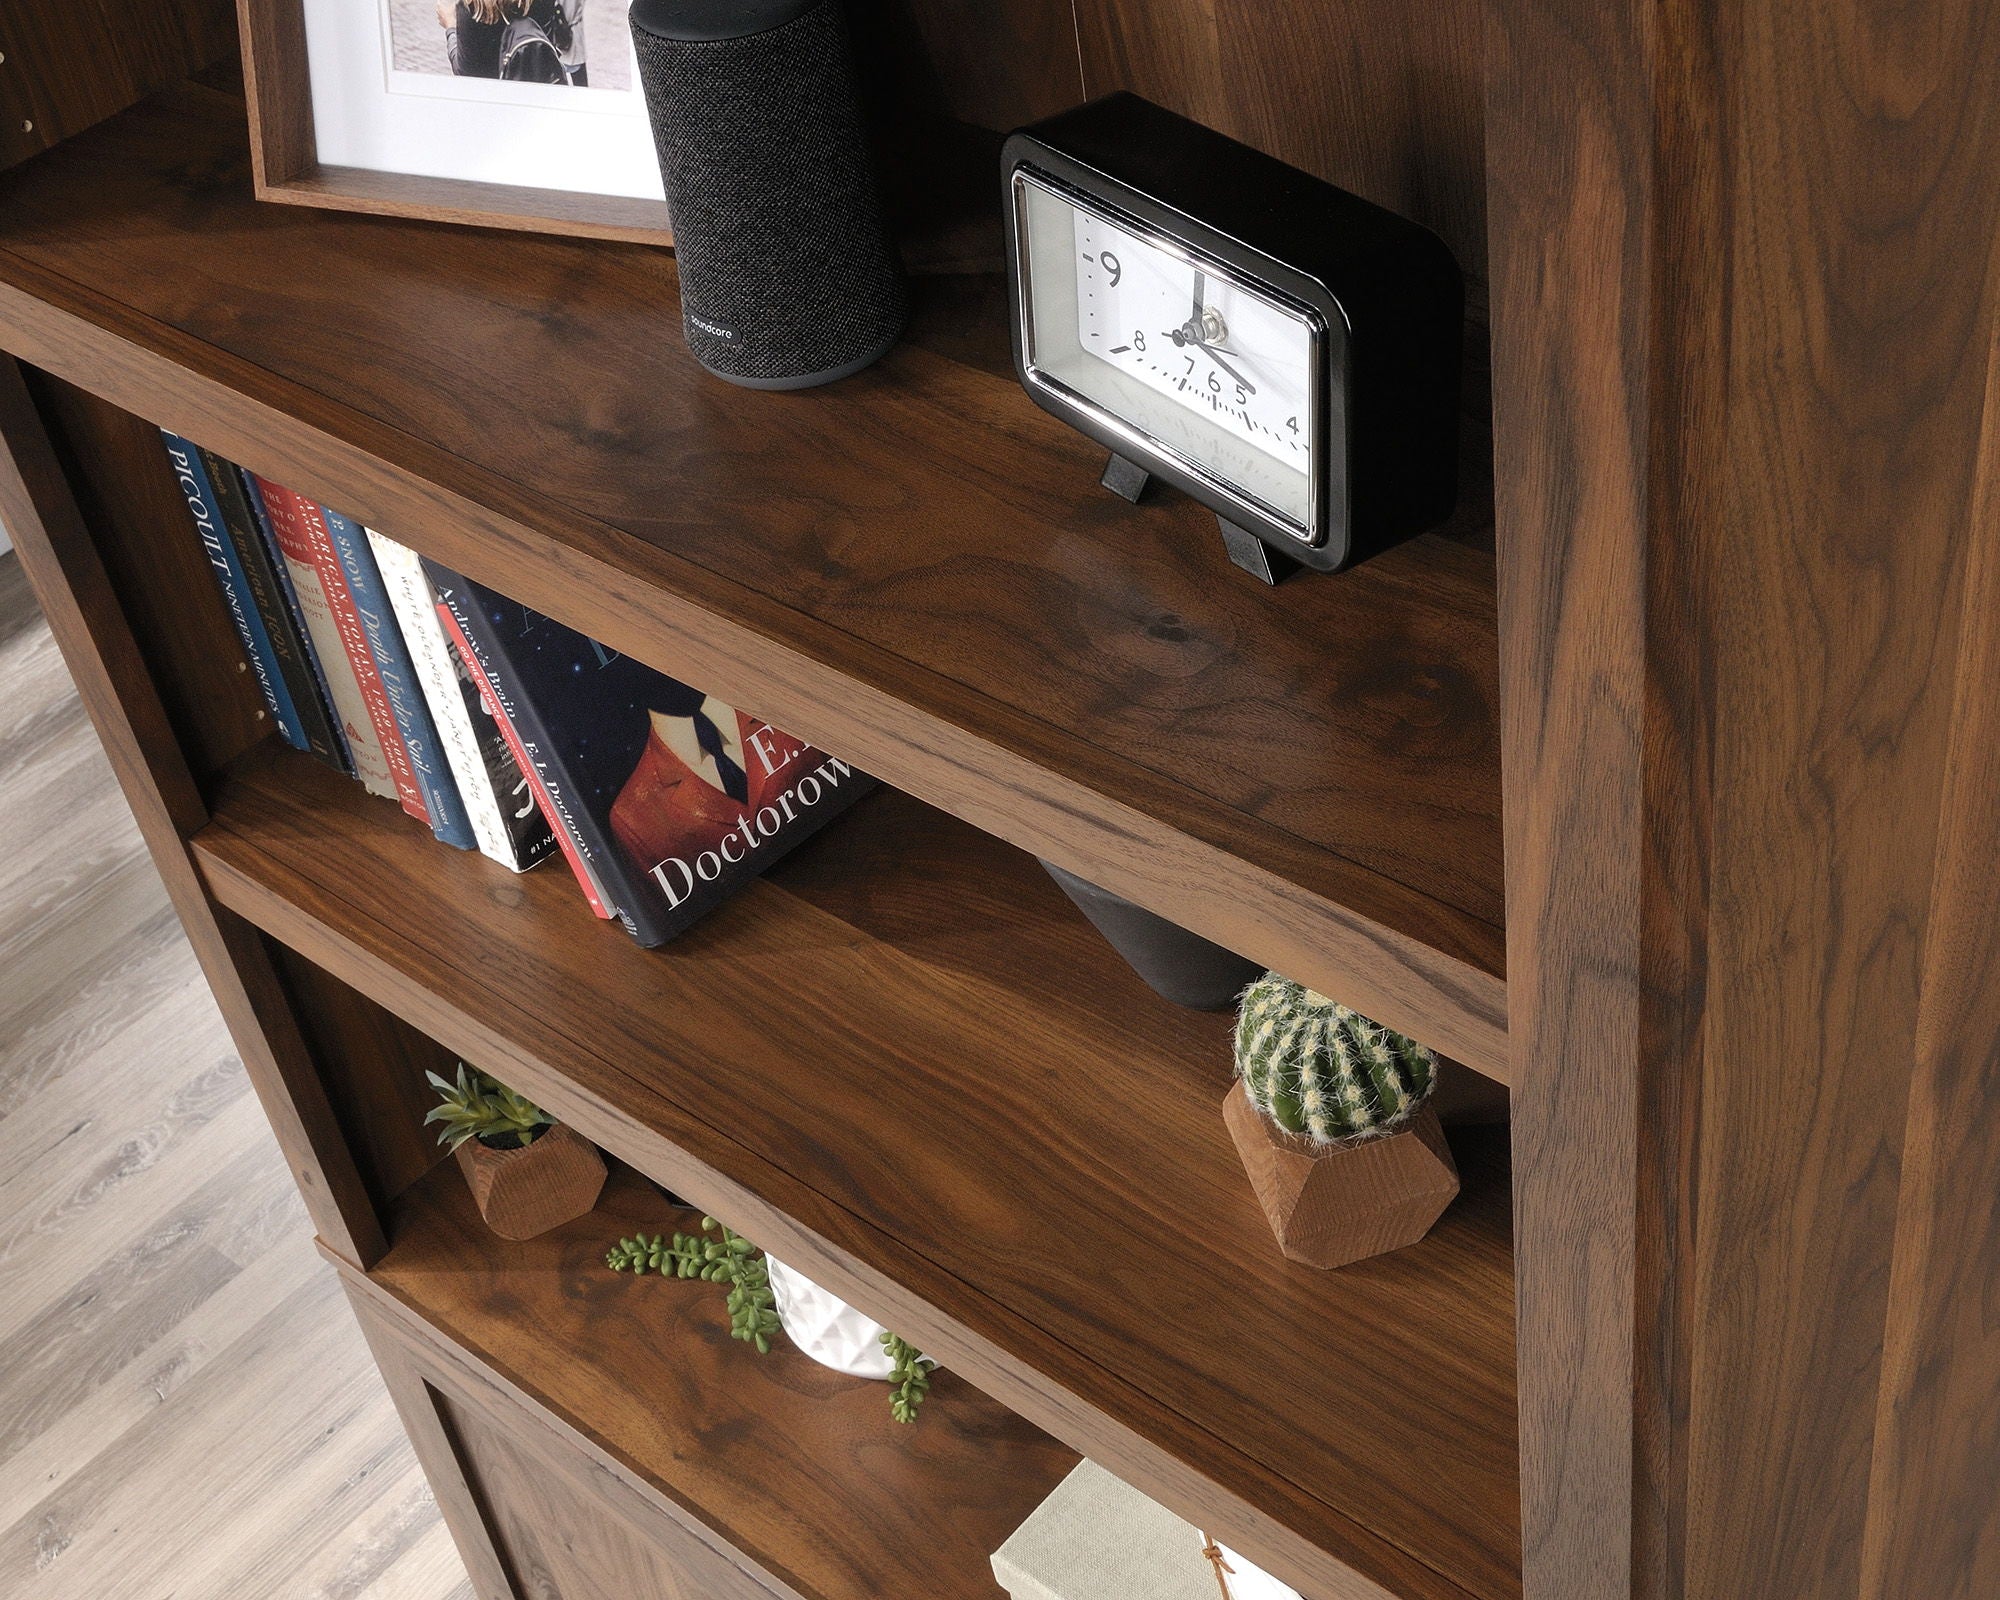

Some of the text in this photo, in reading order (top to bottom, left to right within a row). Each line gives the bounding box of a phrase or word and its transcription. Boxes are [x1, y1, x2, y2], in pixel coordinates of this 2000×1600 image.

[1100, 250, 1122, 288] 9
[690, 314, 733, 339] soundcore
[1133, 329, 1147, 352] 8
[1183, 355, 1196, 375] 7
[1207, 371, 1221, 393] 6
[1235, 384, 1248, 406] 5
[1286, 416, 1300, 436] 4
[167, 446, 233, 578] PICOULT
[222, 580, 258, 656] NINETEEN
[250, 655, 281, 714] MINUTES
[231, 522, 292, 661] American ICON
[299, 504, 320, 550] CYNTHIA
[321, 567, 344, 621] COSTELLO,
[342, 624, 357, 653] SHARI
[354, 656, 368, 687] MILES,
[369, 705, 383, 728] ANNE
[384, 741, 398, 769] STONE
[304, 499, 410, 776] AMERICAN WOMAN 1999-2000
[332, 517, 432, 774] P. SNOW Death Under Sail
[401, 576, 423, 619] WHITE
[417, 625, 447, 698] OLEANDER
[460, 646, 470, 659] GO
[468, 660, 480, 678] THE
[479, 679, 502, 720] DISTANCE
[440, 586, 596, 862] Andrew's Brain E. L. Doctorow
[648, 757, 852, 911] Doctorow
